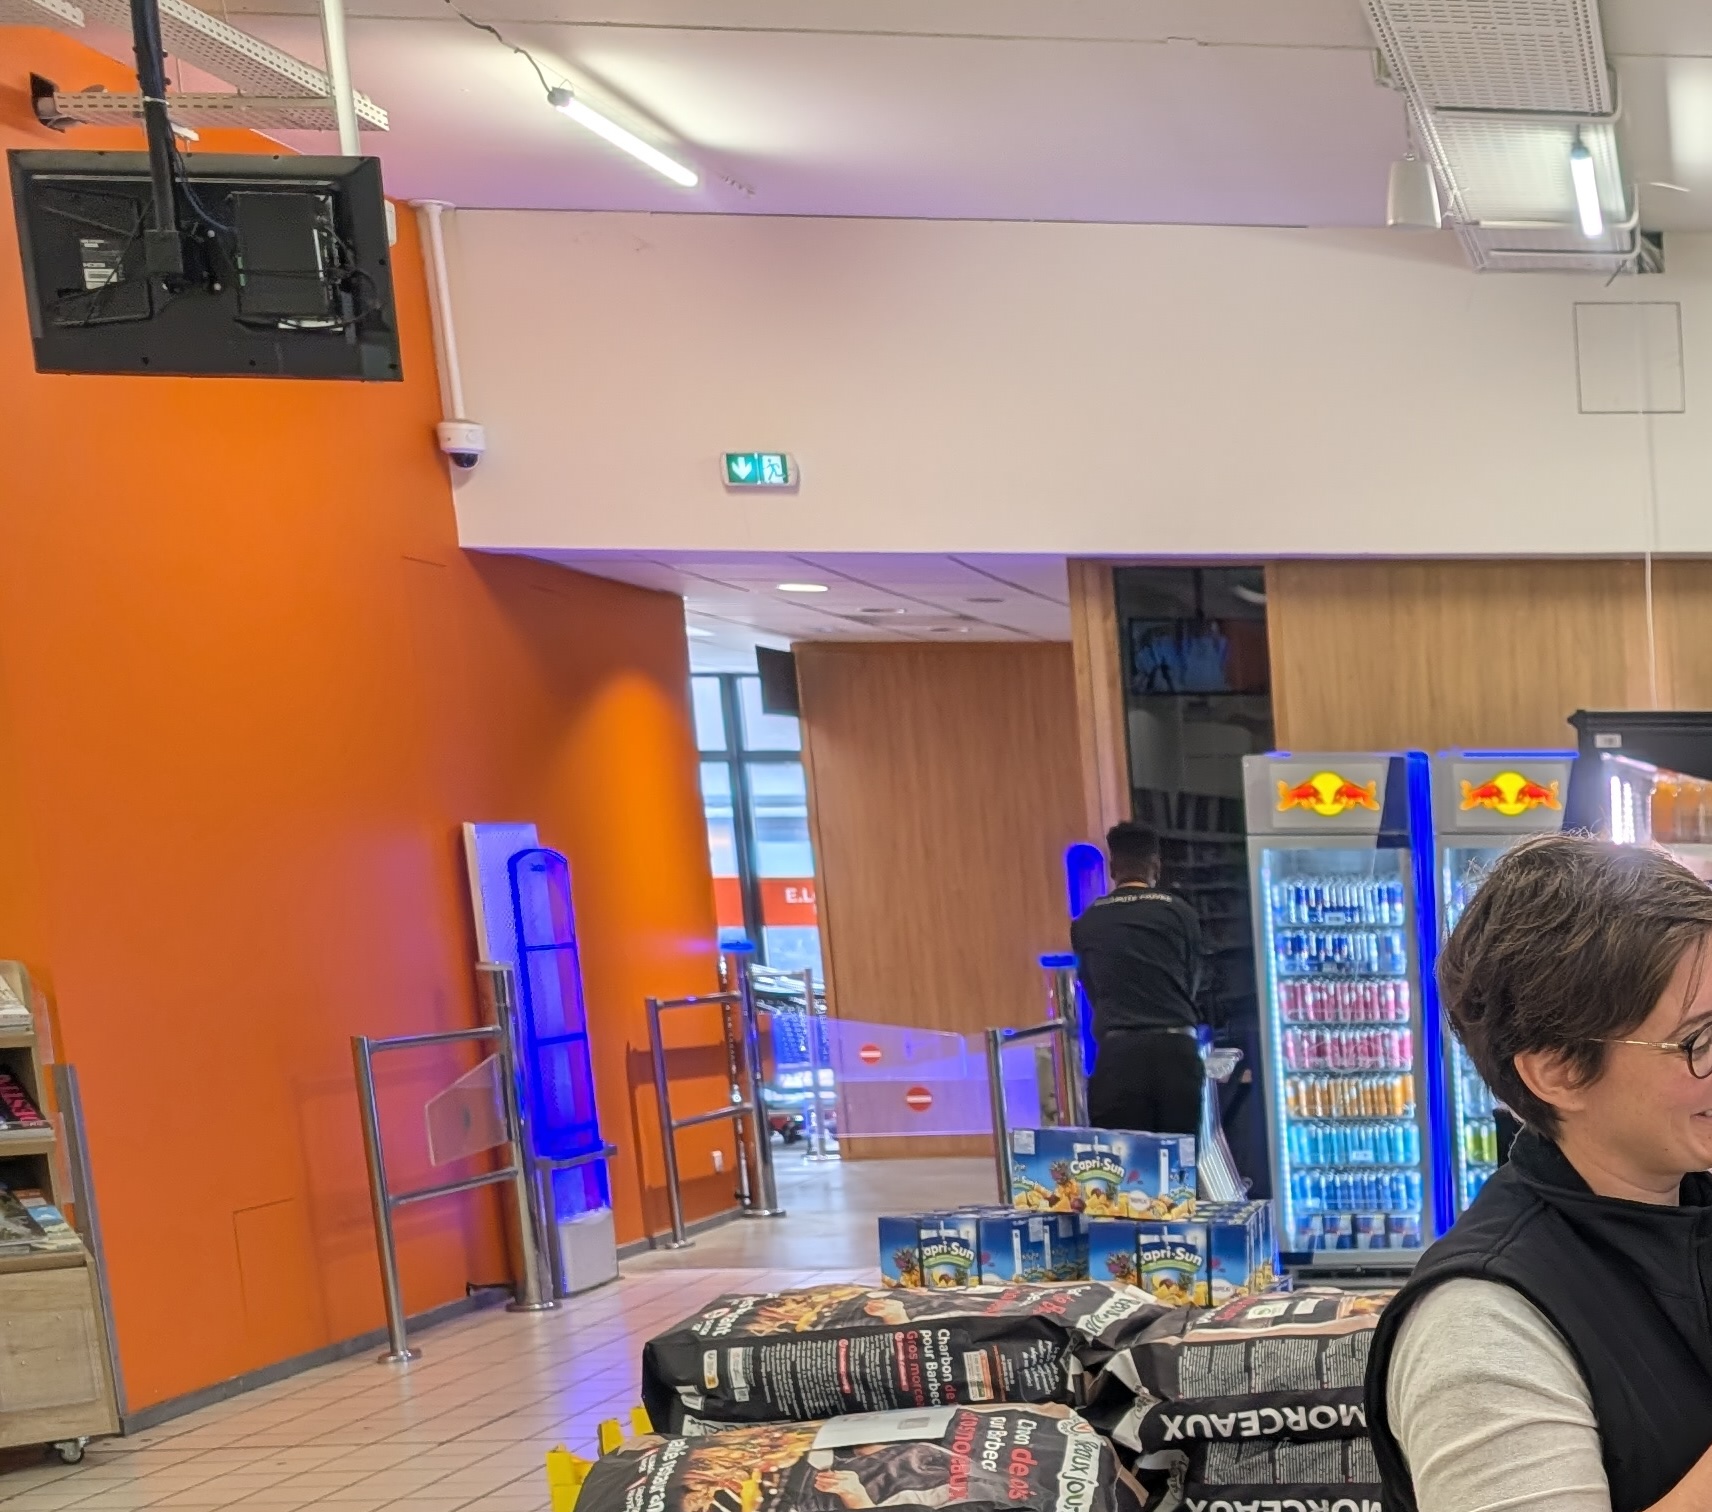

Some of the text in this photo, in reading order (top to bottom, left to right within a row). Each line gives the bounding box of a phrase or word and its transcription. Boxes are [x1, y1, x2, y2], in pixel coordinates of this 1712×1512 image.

[1069, 1155, 1126, 1179] Capri-Sun
[906, 1330, 919, 1359] Gros
[919, 1329, 934, 1360] pour
[937, 1328, 954, 1383] Charbon
[1160, 1403, 1367, 1442] MORCEAUX
